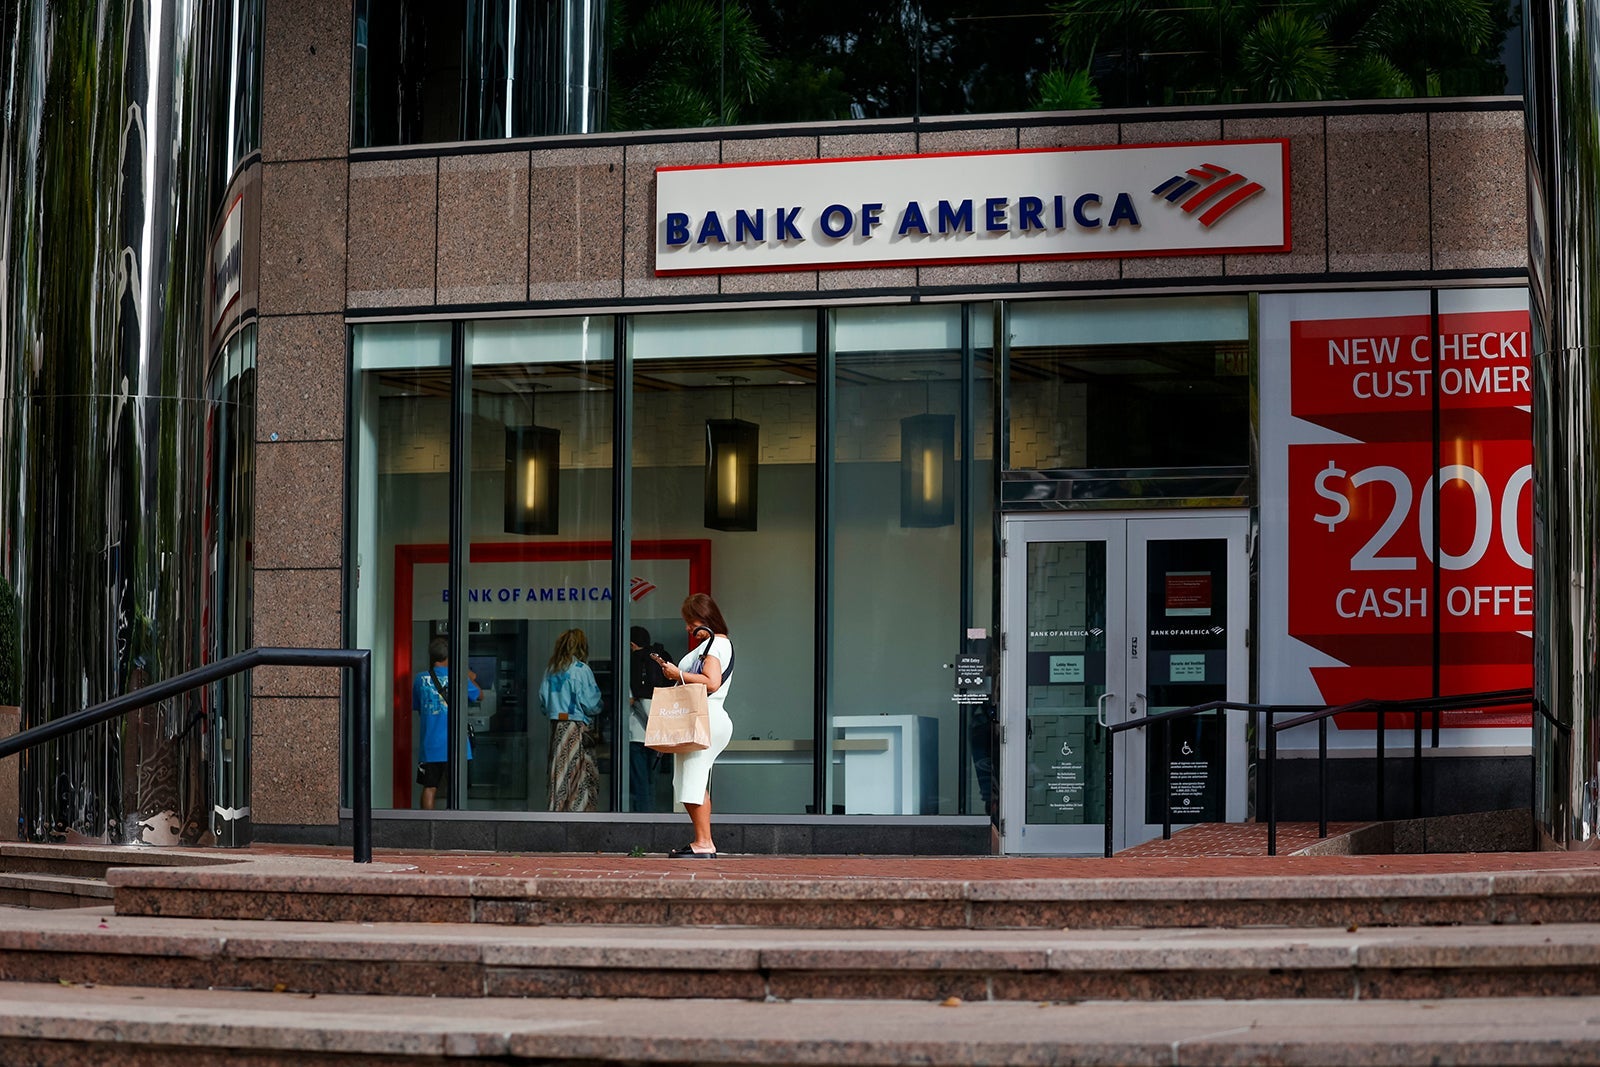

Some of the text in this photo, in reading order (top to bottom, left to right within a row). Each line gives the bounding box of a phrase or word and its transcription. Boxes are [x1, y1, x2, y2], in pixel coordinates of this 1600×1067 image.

[666, 192, 1141, 246] BANK OF AMERICA
[1328, 332, 1527, 366] NEW CHECKI
[1352, 366, 1531, 399] CUSTOMER
[442, 586, 612, 602] BNK OF AMERICA
[1335, 585, 1533, 619] CASH OFFE
